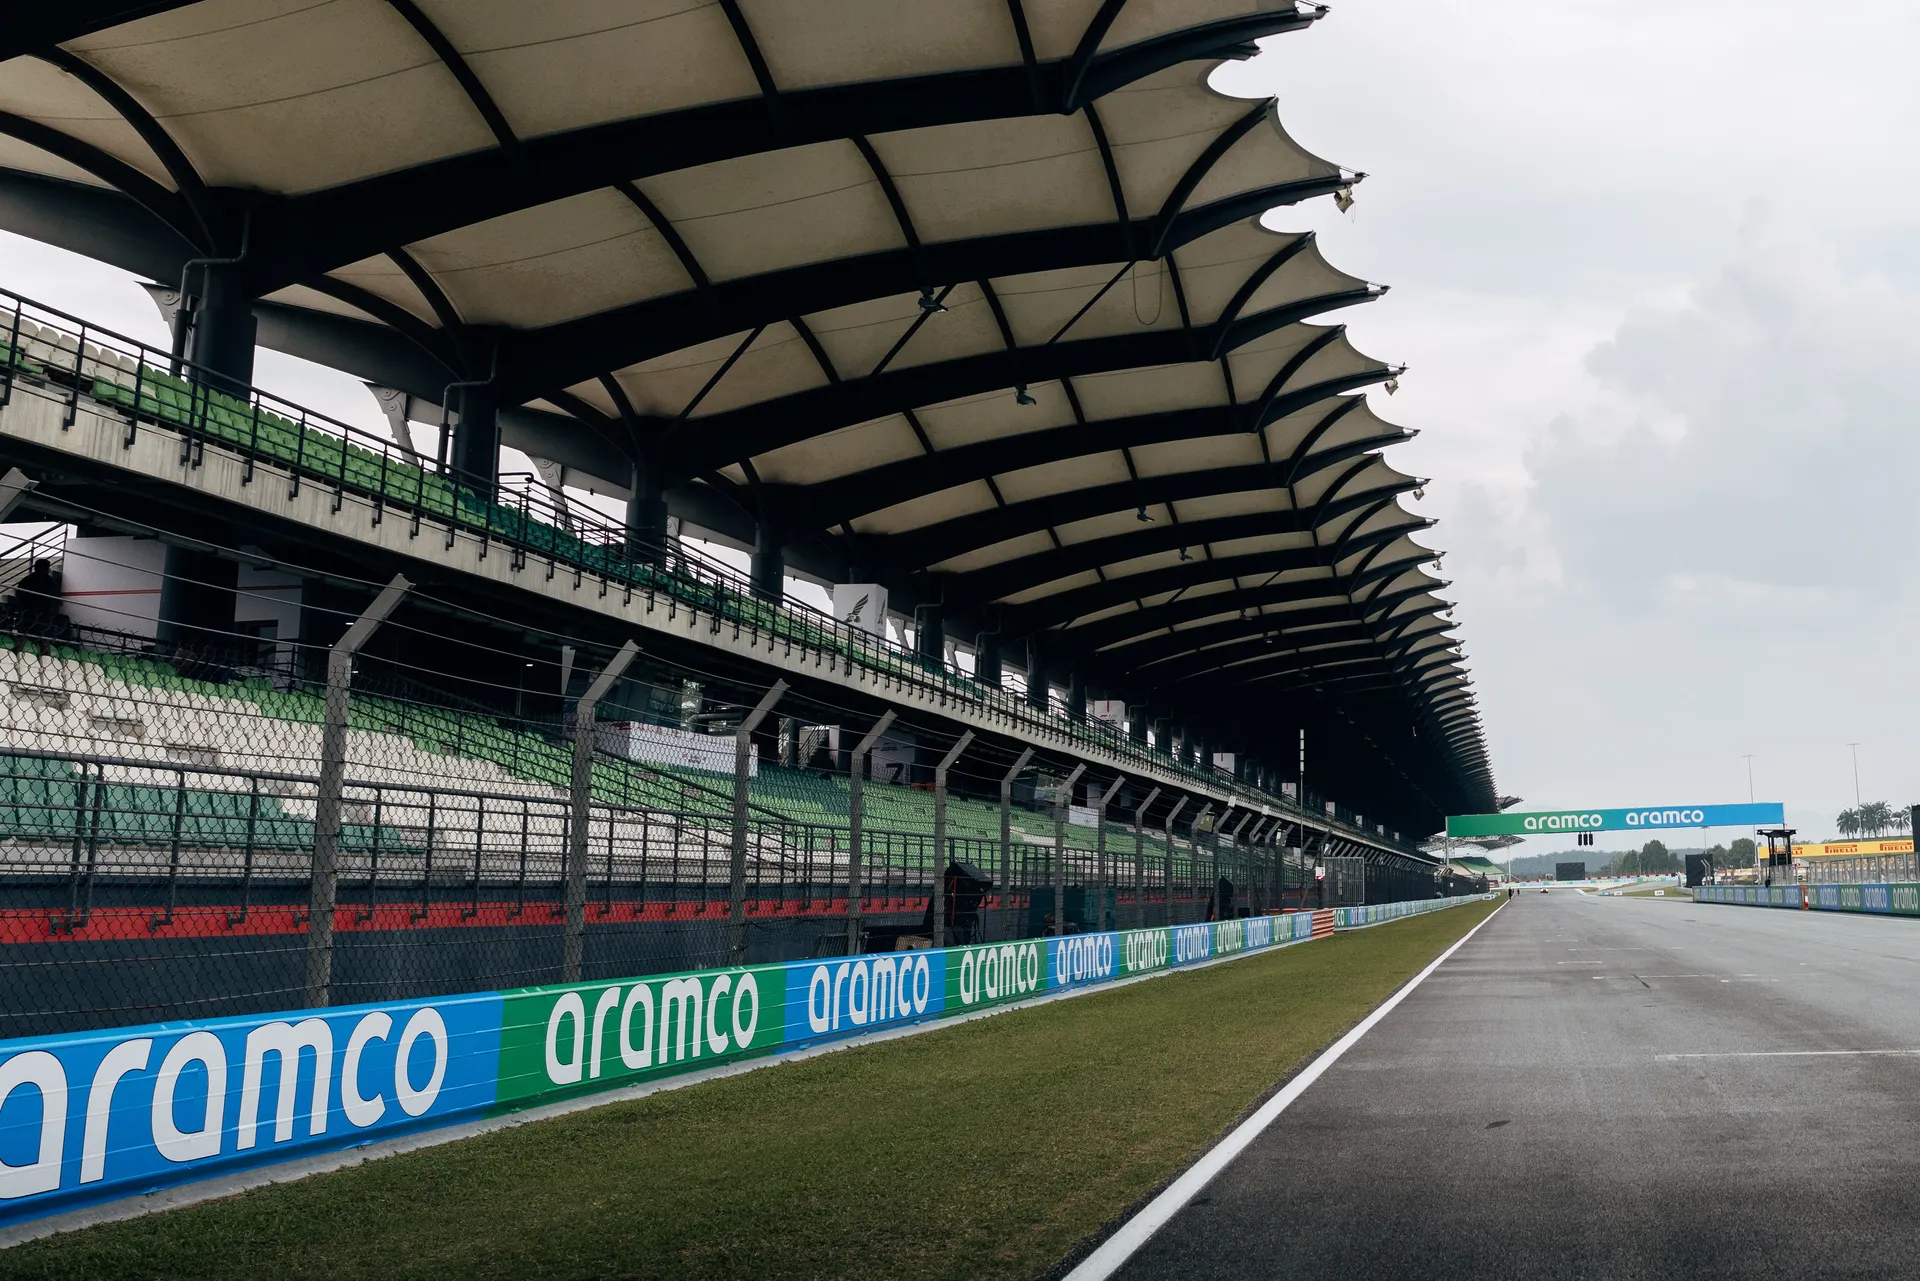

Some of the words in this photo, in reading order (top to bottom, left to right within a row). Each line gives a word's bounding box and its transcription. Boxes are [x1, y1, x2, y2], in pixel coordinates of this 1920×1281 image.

[1524, 814, 1602, 830] aramco
[1626, 810, 1704, 825] aramco
[1825, 844, 1857, 853] PIRELLI
[1880, 842, 1912, 851] PIRELLI
[1893, 887, 1918, 909] aramco
[1126, 930, 1167, 971] aramco
[1176, 926, 1209, 962] aramco
[1217, 921, 1242, 953] aramco
[960, 943, 1038, 1004] aramco
[1056, 935, 1112, 984] aramco
[808, 954, 930, 1033] aramco
[545, 972, 759, 1085] aramco
[0, 1007, 448, 1199] aramco
